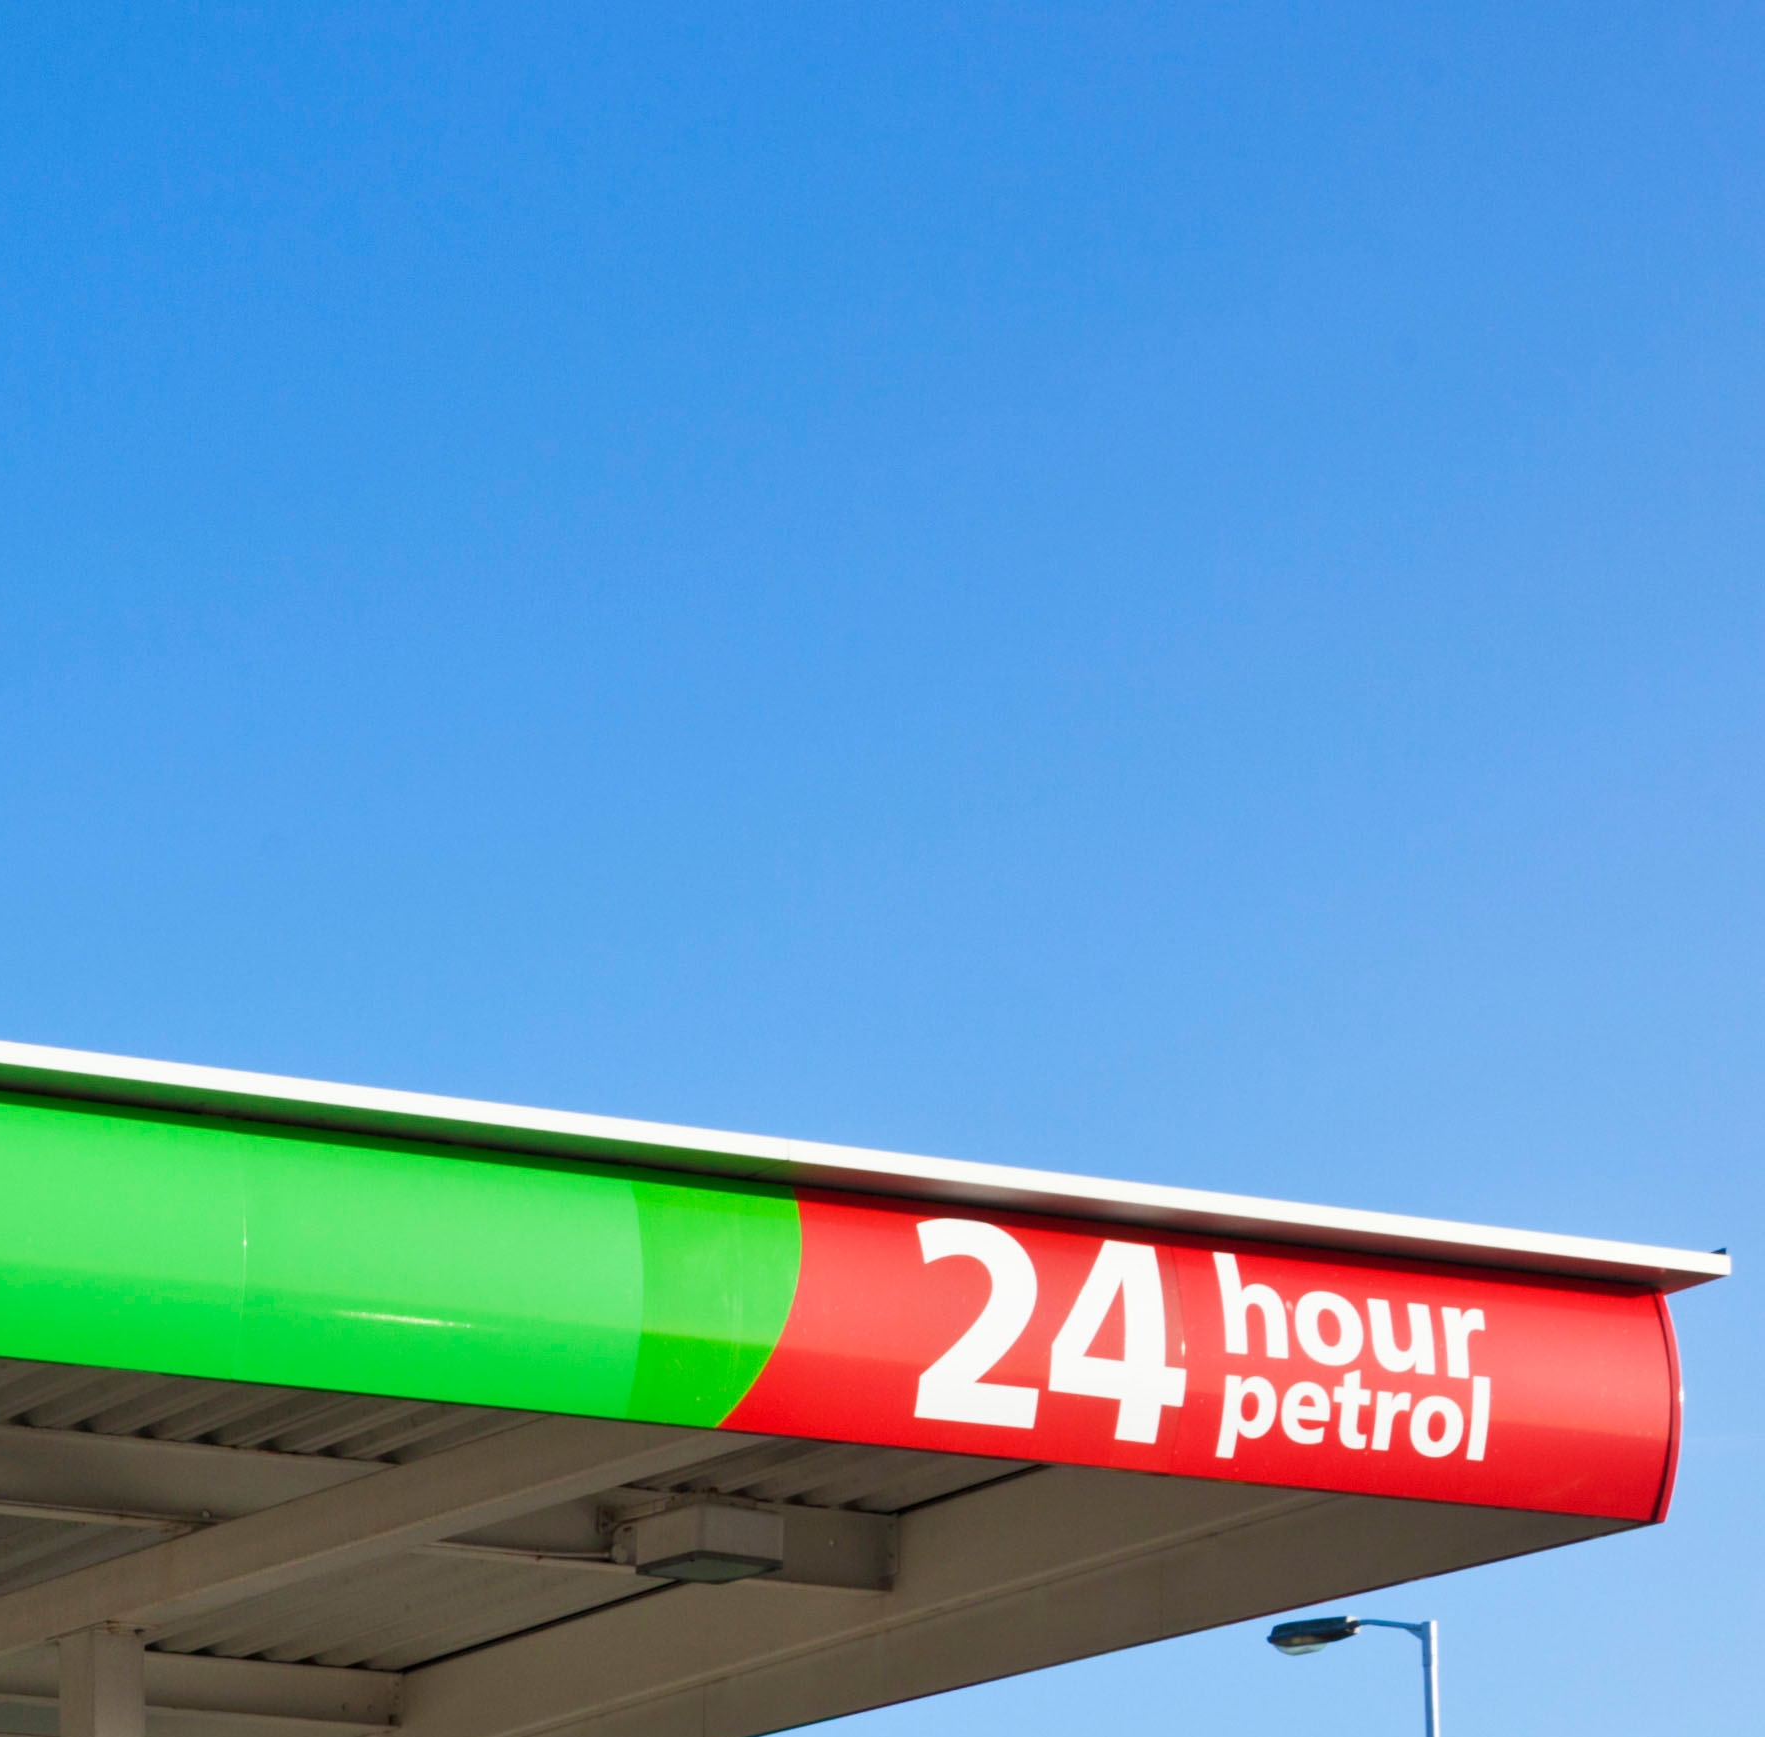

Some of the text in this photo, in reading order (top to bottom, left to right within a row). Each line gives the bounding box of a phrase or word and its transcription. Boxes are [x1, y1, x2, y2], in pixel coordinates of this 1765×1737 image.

[914, 1217, 1186, 1444] 24
[1213, 1252, 1485, 1379] hour
[1215, 1371, 1491, 1461] petrol
